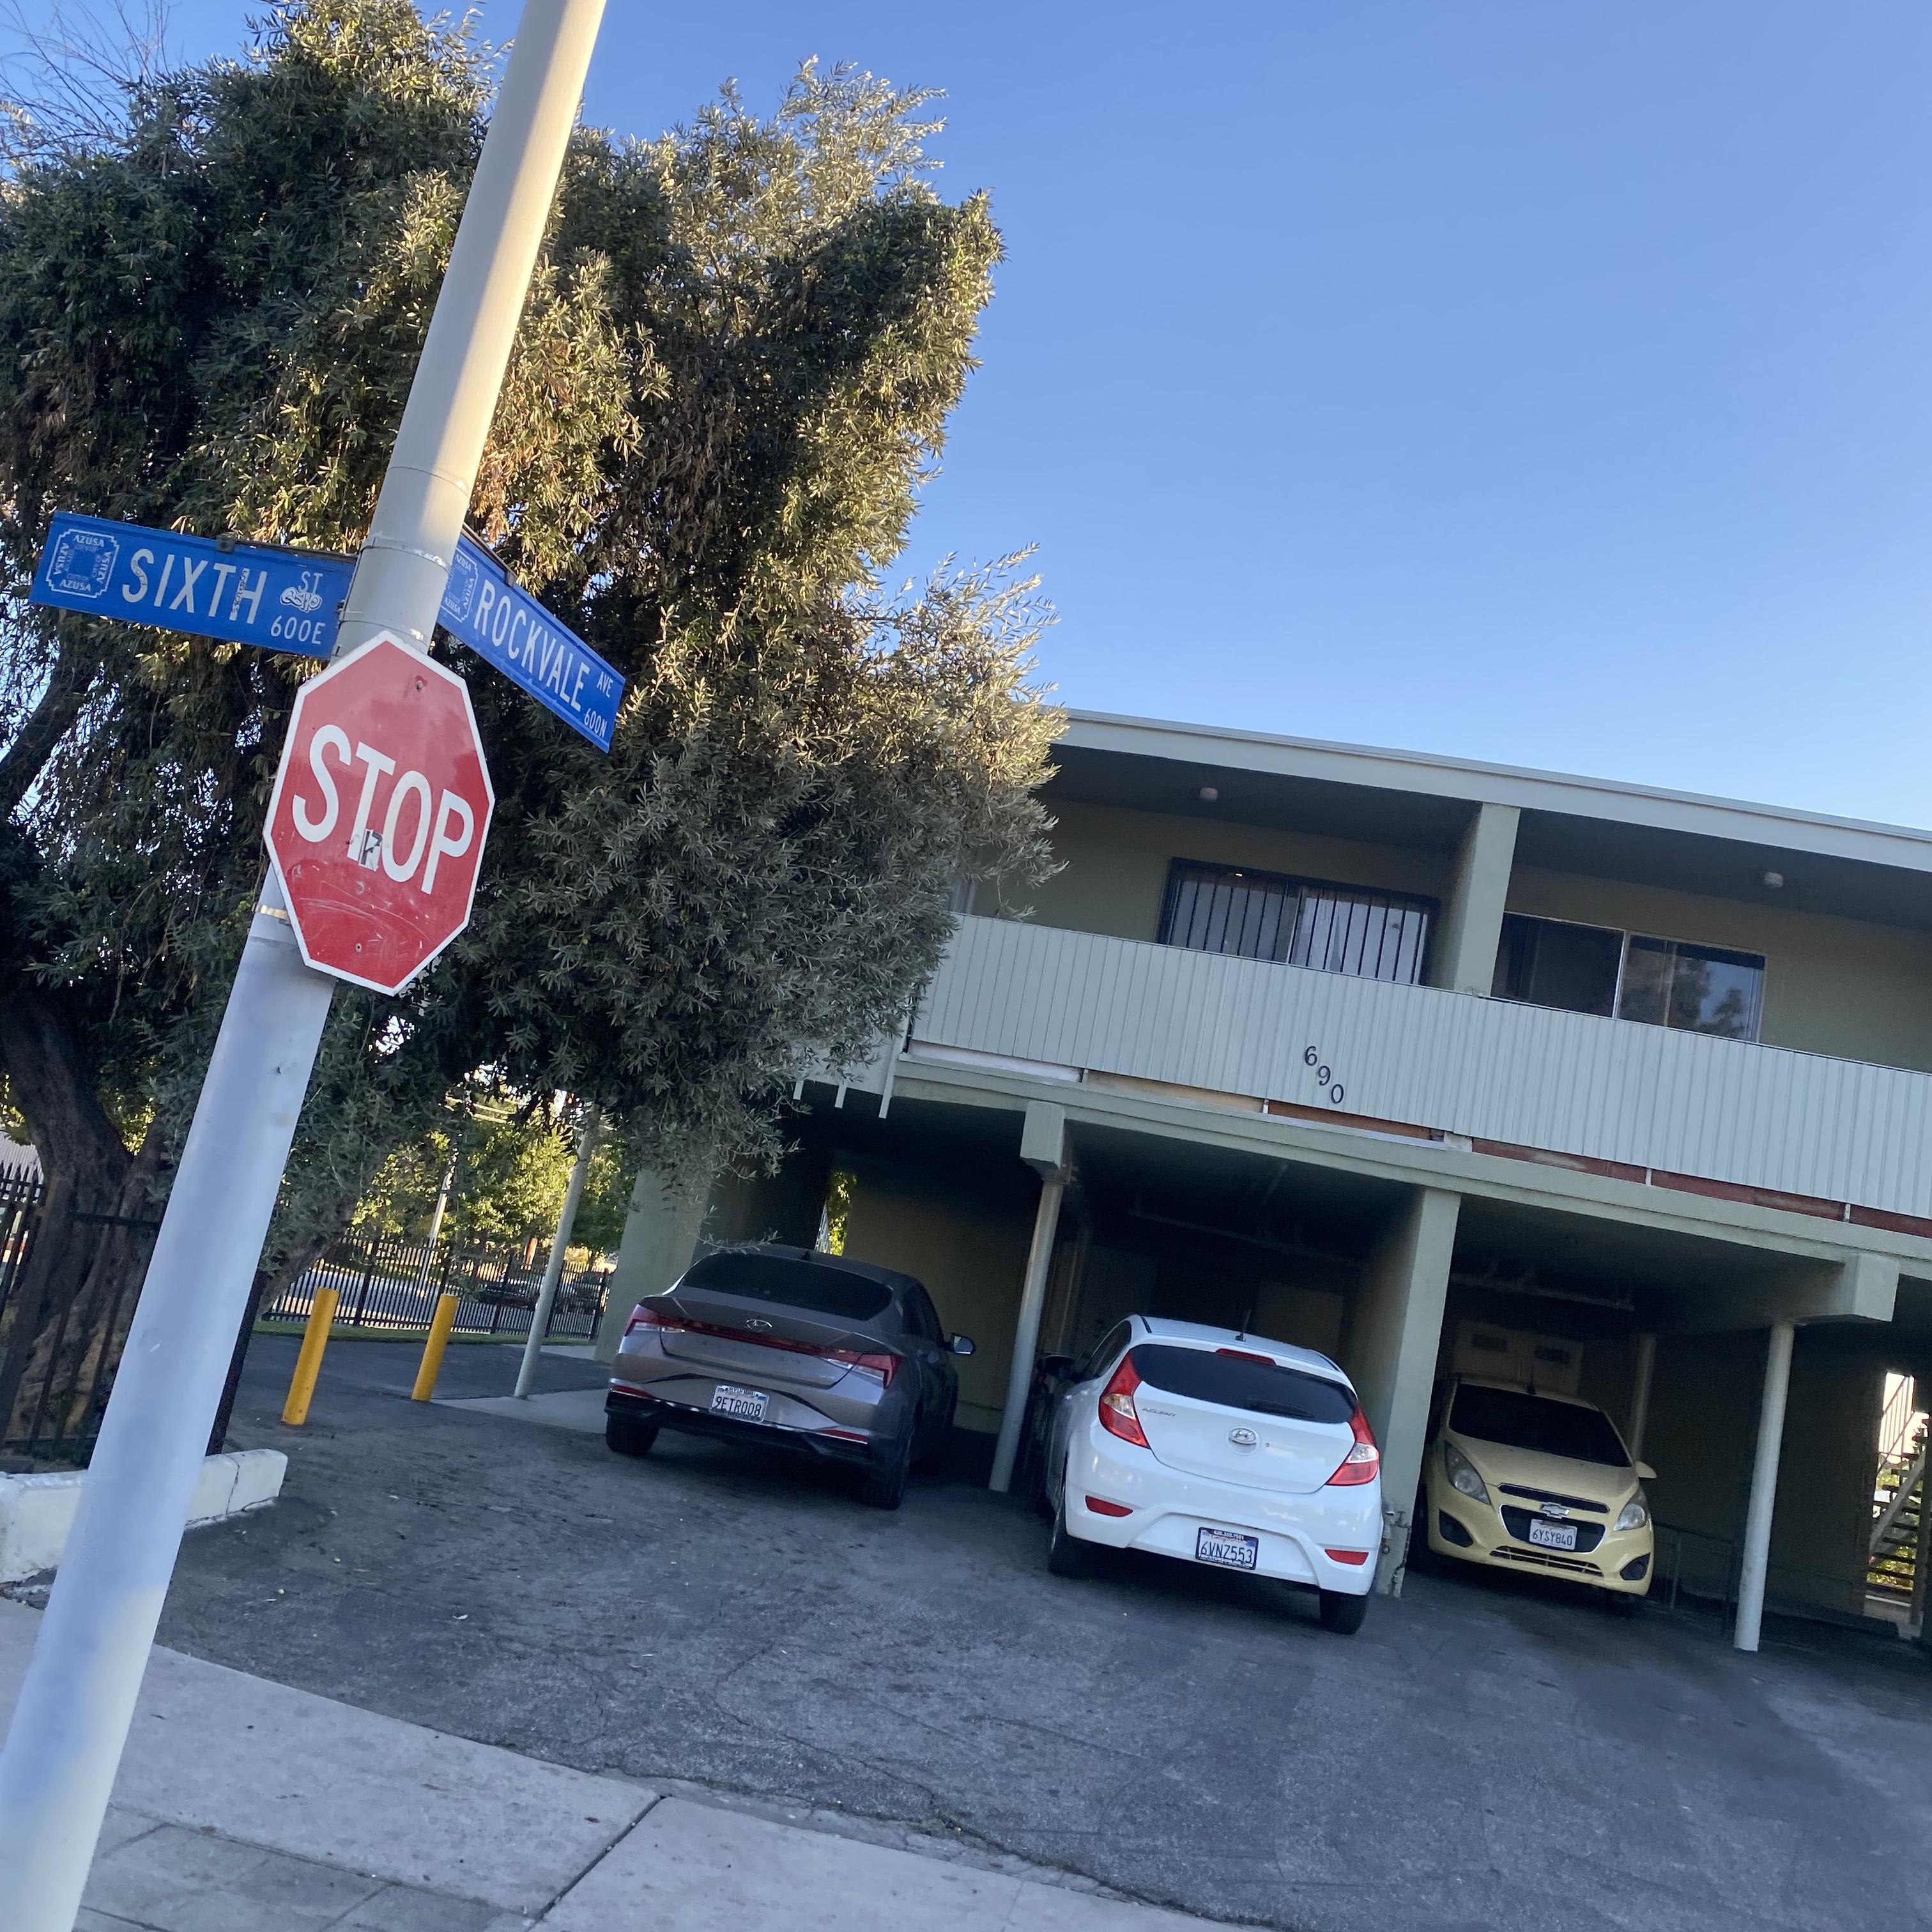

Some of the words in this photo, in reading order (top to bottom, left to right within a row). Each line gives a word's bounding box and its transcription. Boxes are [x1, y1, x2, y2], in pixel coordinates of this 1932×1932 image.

[73, 535, 104, 548] AZUSA
[60, 579, 91, 592] AZUSA
[122, 548, 267, 625] SIXTH
[298, 571, 323, 594] ST
[270, 615, 325, 645] 600E
[473, 579, 590, 711] ROCKVALE
[596, 671, 613, 698] AVE
[583, 707, 608, 739] 600N
[292, 724, 474, 895] STOP
[1305, 1046, 1344, 1105] 690
[715, 1396, 762, 1416] 9ETR008
[1533, 1529, 1573, 1546] 6YSY840
[1200, 1541, 1253, 1564] 6VNZ553
